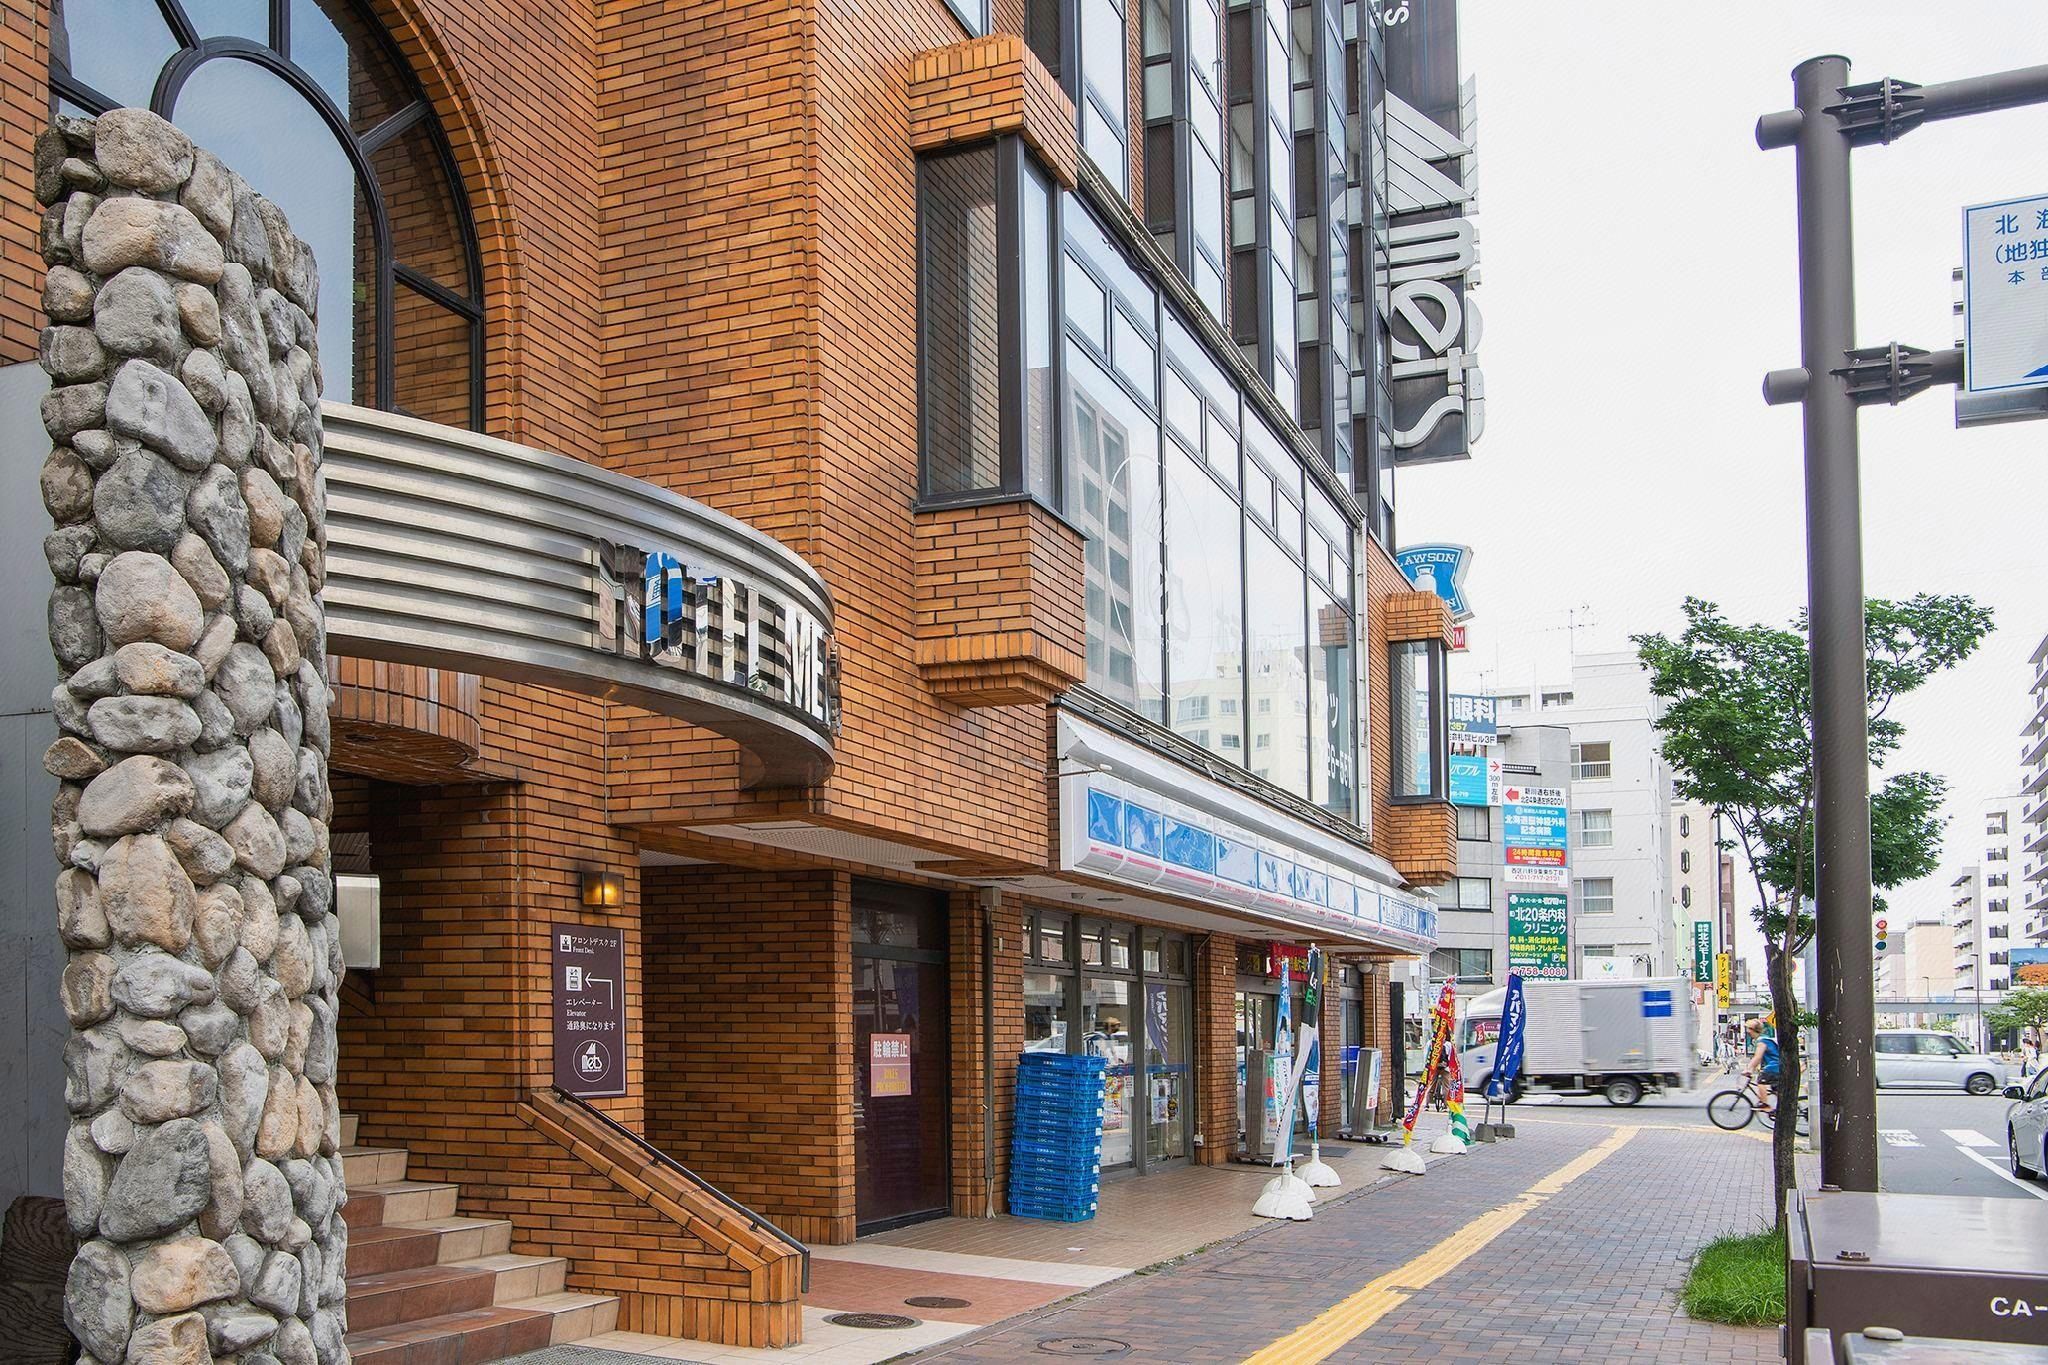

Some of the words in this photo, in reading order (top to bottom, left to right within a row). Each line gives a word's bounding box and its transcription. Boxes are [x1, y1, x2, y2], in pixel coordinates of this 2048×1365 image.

[593, 537, 768, 692] HOTEL
[775, 602, 842, 737] ME
[1515, 907, 1566, 922] 北20条内科
[1523, 923, 1566, 935] クリニック
[571, 936, 609, 948] フロントデスク
[565, 998, 603, 1007] エレベーター
[566, 1009, 587, 1017] Elevator
[566, 1020, 616, 1032] 通路奥になります
